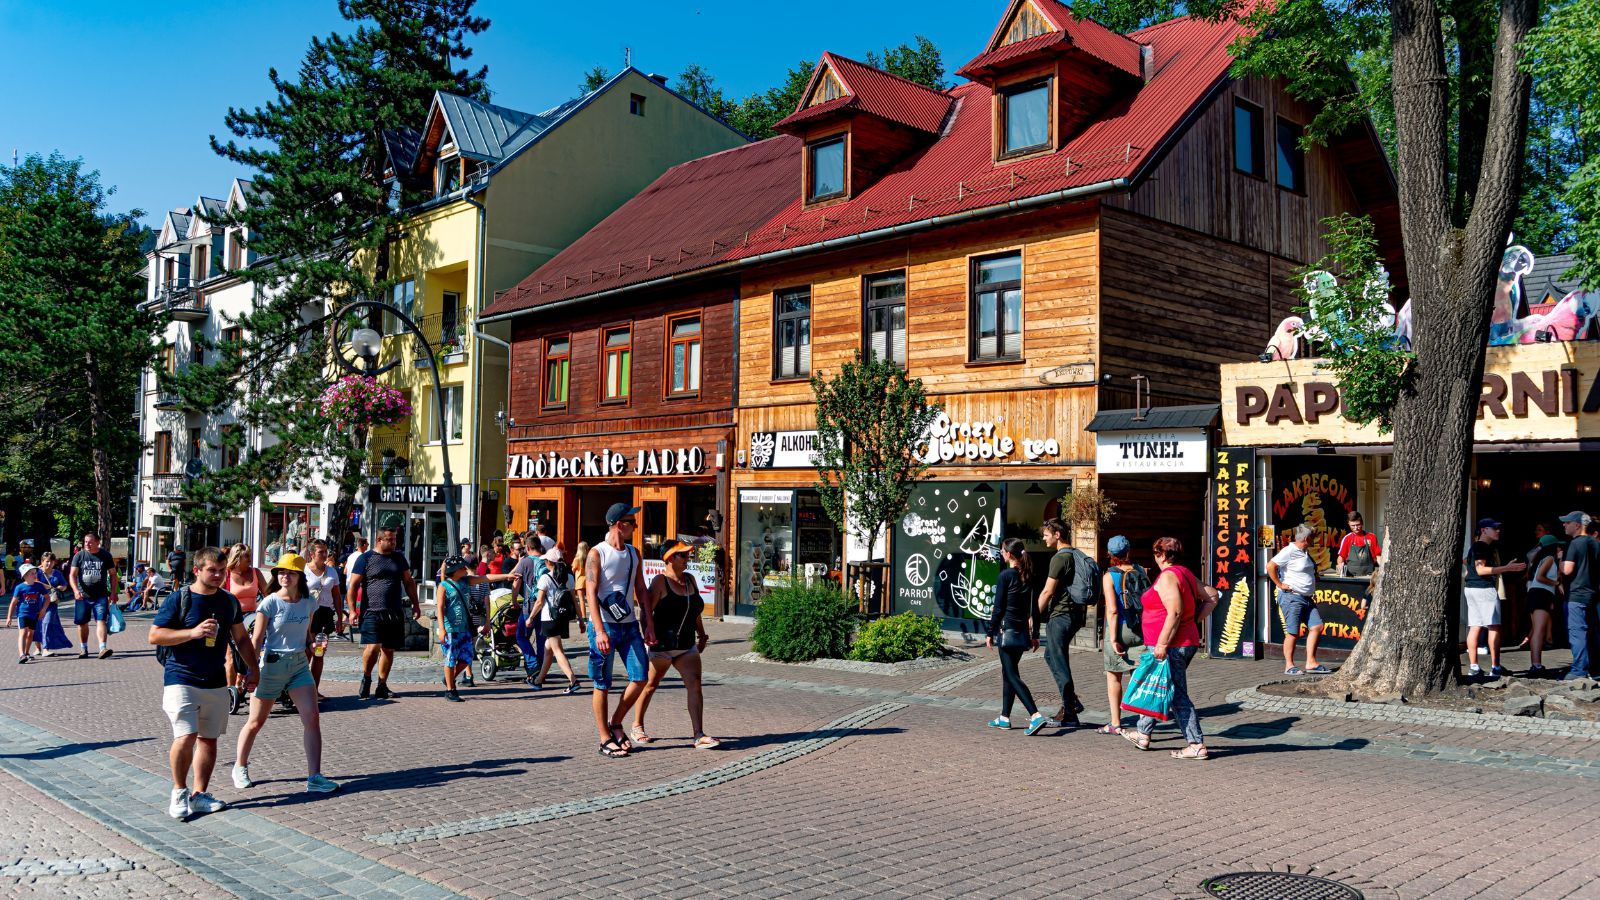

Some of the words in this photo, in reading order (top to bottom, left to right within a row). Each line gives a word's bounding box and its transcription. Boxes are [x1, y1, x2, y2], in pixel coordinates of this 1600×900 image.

[1022, 437, 1059, 460] tea
[1120, 441, 1184, 459] TUNEL
[633, 446, 703, 475] JADŁO
[1116, 460, 1185, 468] RESTAURACJA
[380, 486, 406, 502] GREY
[408, 486, 438, 502] WOLF
[1234, 463, 1250, 563] FRYTKA
[930, 534, 946, 545] tea
[83, 560, 104, 570] NEW
[899, 586, 933, 599] PARROT
[1299, 622, 1361, 641] FYTKA
